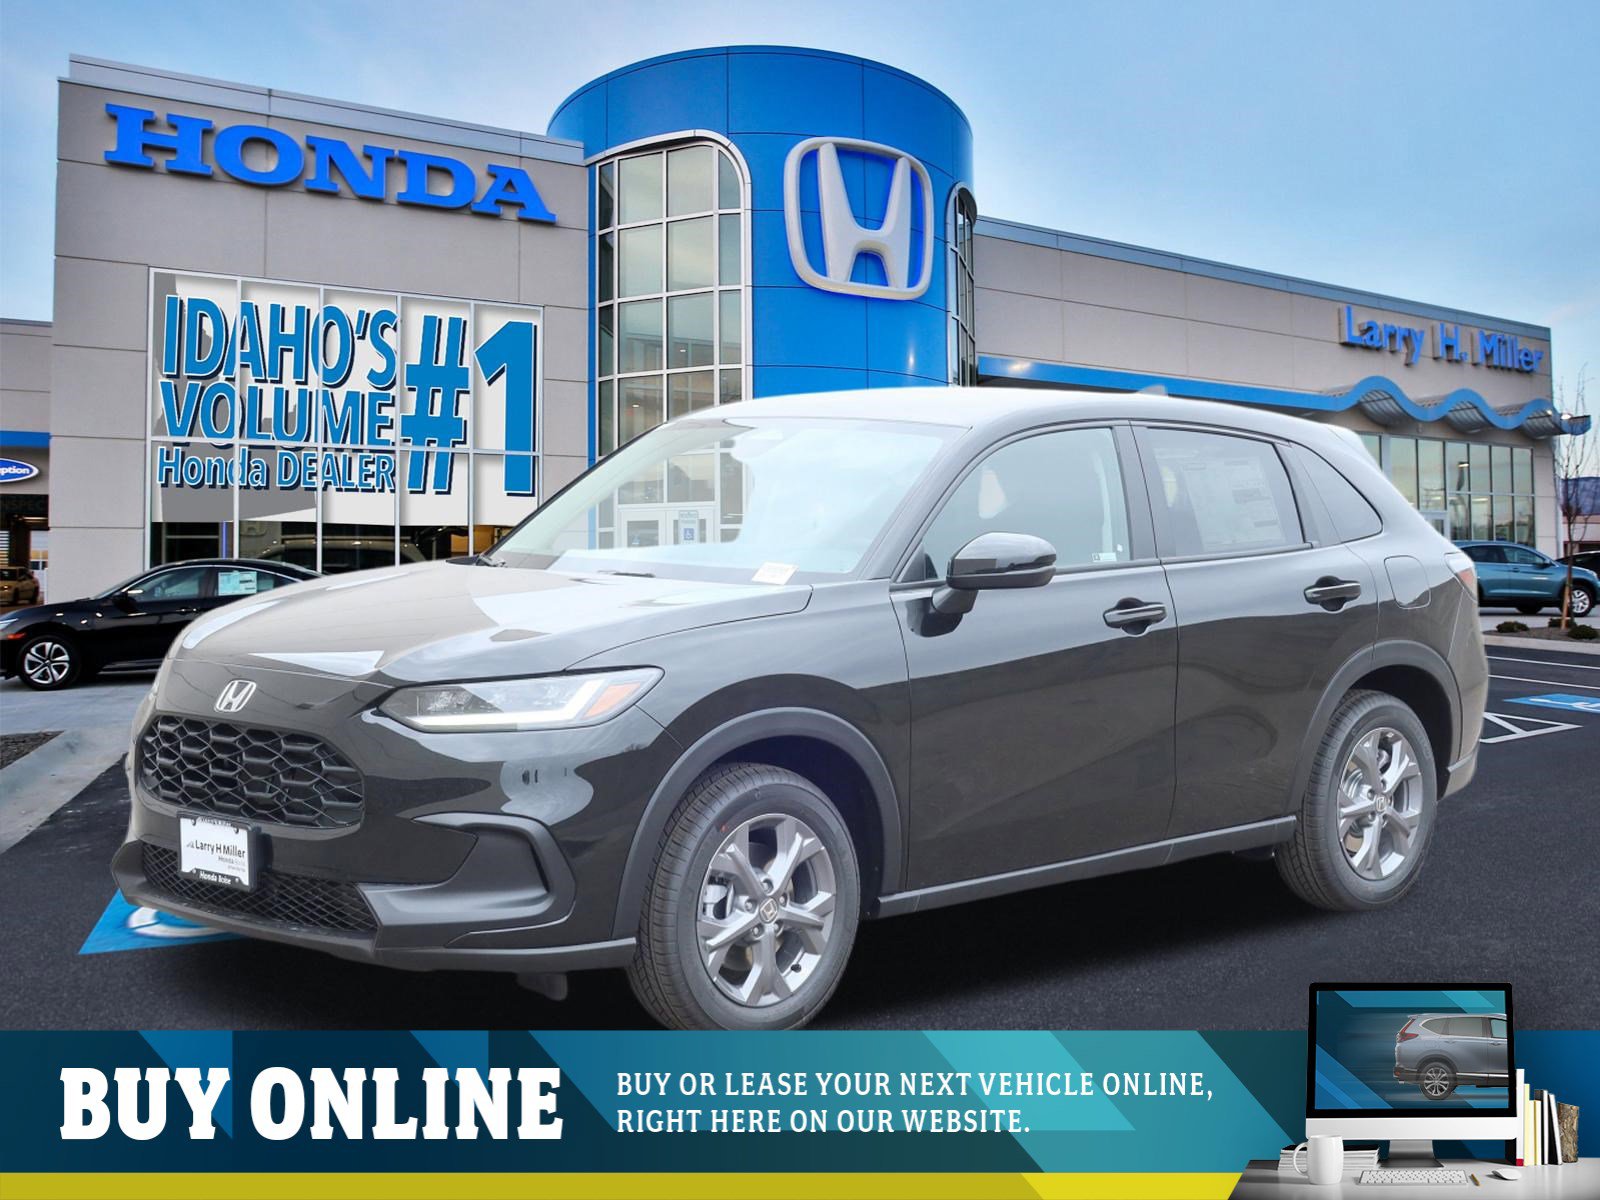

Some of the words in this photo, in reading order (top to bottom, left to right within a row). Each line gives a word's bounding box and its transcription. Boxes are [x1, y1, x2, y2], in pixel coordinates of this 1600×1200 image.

[104, 103, 557, 222] HONDA
[163, 295, 398, 389] IDAHO'S
[1341, 305, 1425, 366] Larry
[1436, 322, 1468, 362] H.
[1475, 329, 1544, 372] Miller
[159, 380, 397, 449] VOLUME
[401, 315, 537, 497] #1
[157, 446, 269, 490] Honda
[276, 450, 397, 492] DEALER
[195, 840, 215, 855] Larry
[216, 843, 222, 854] H
[223, 844, 246, 858] Miller
[199, 870, 217, 882] Honda
